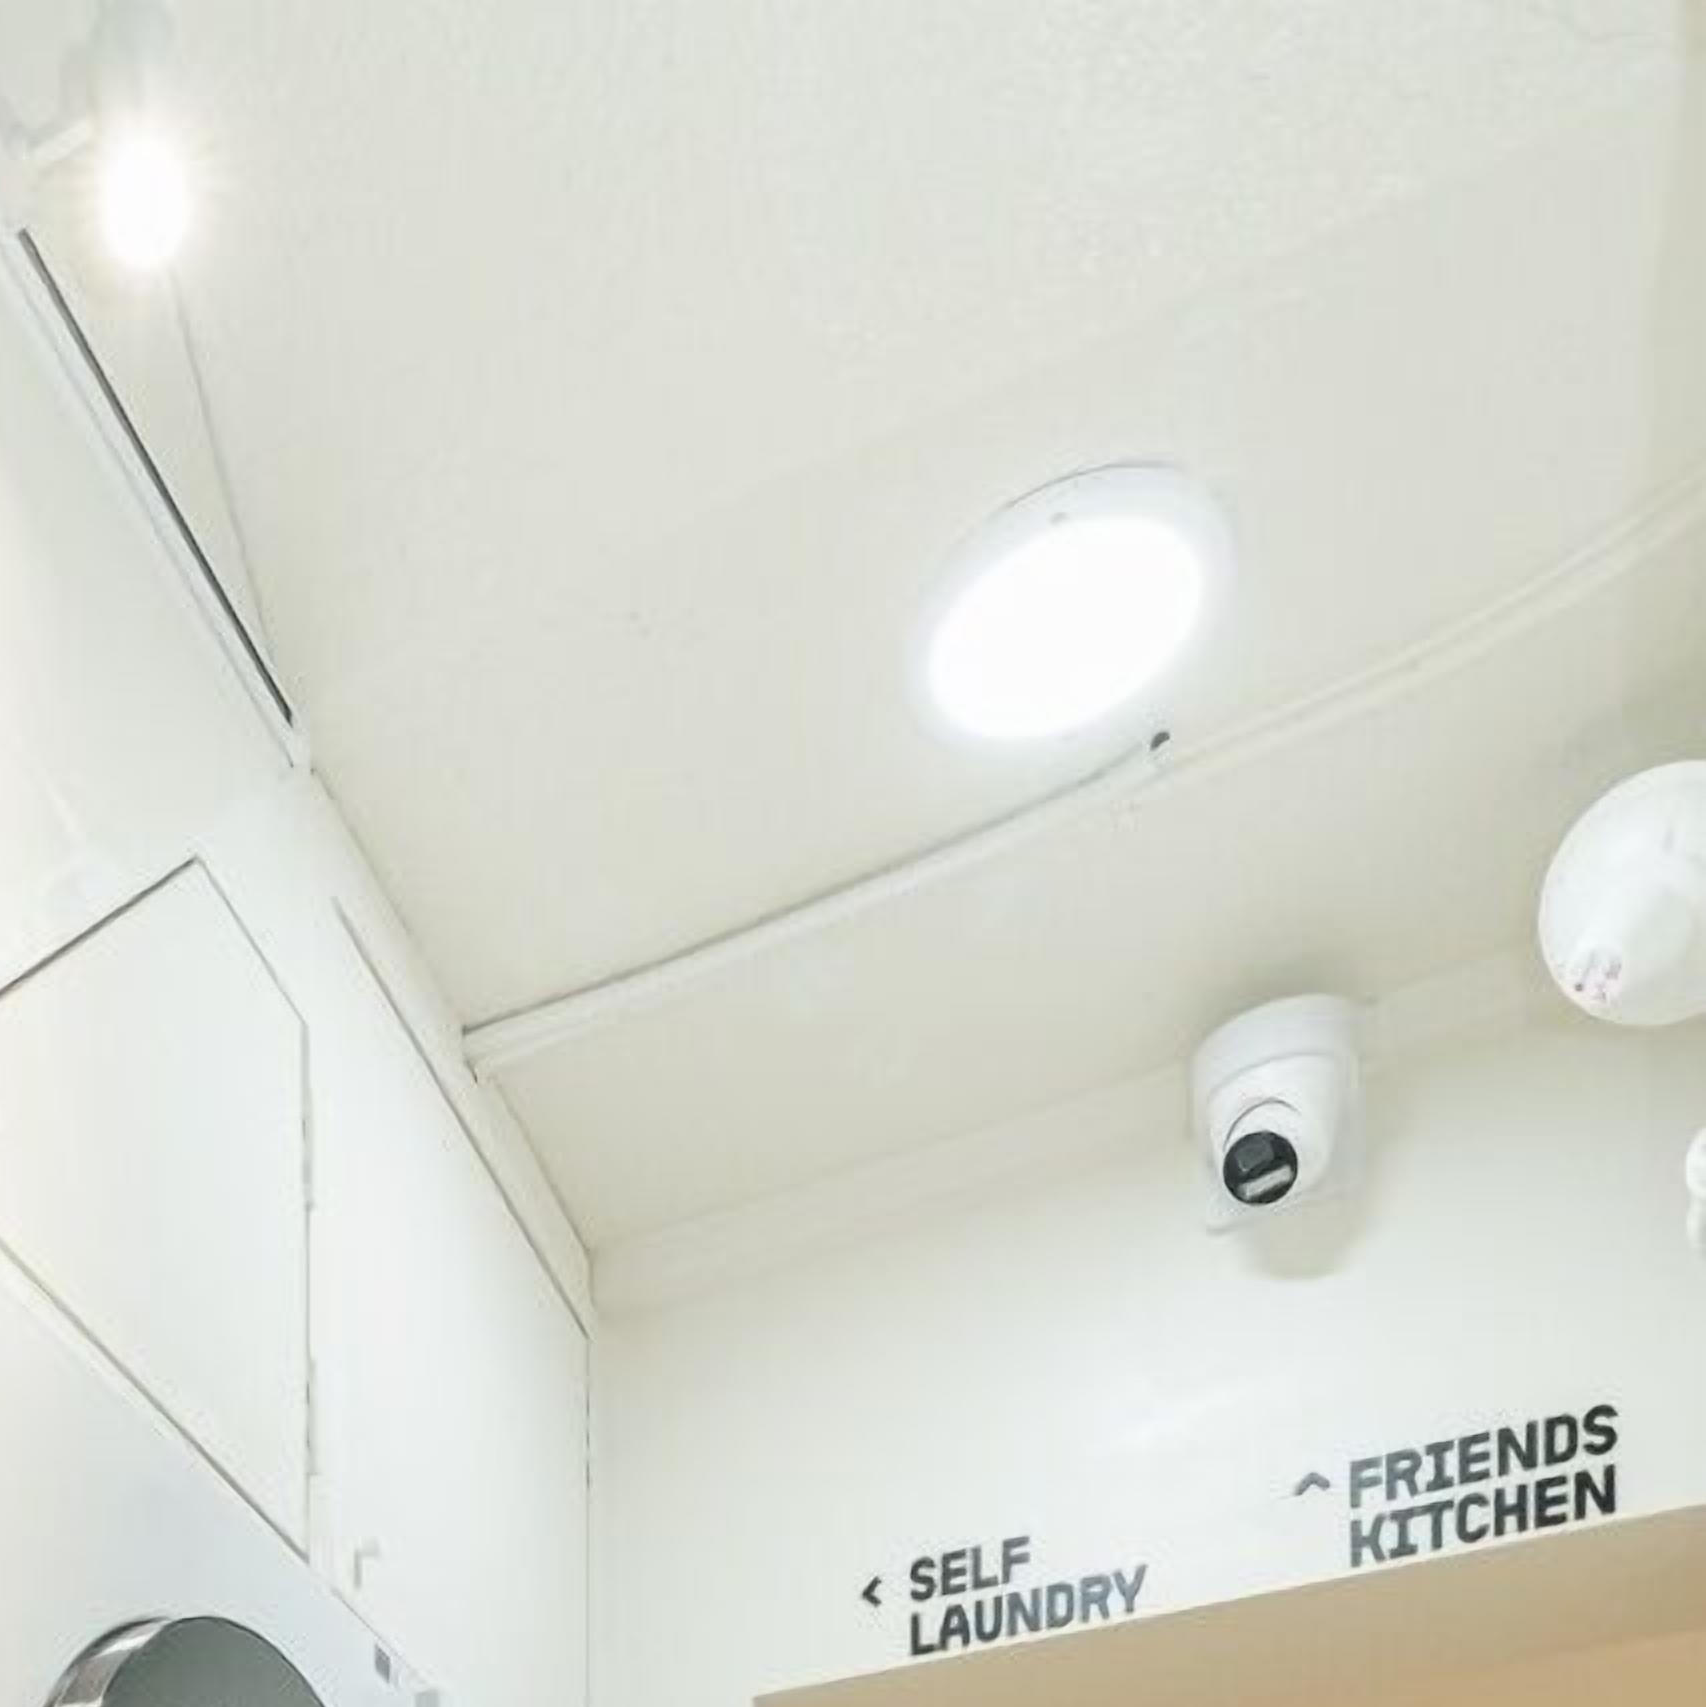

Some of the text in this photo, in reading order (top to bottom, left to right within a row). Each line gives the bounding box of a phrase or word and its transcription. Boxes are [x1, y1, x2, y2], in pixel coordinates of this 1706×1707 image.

[1350, 1404, 1618, 1509] FRIENDS
[1350, 1464, 1616, 1567] KITCHEN
[910, 1535, 1030, 1602] SELF
[910, 1564, 1147, 1656] LAUNDRY
